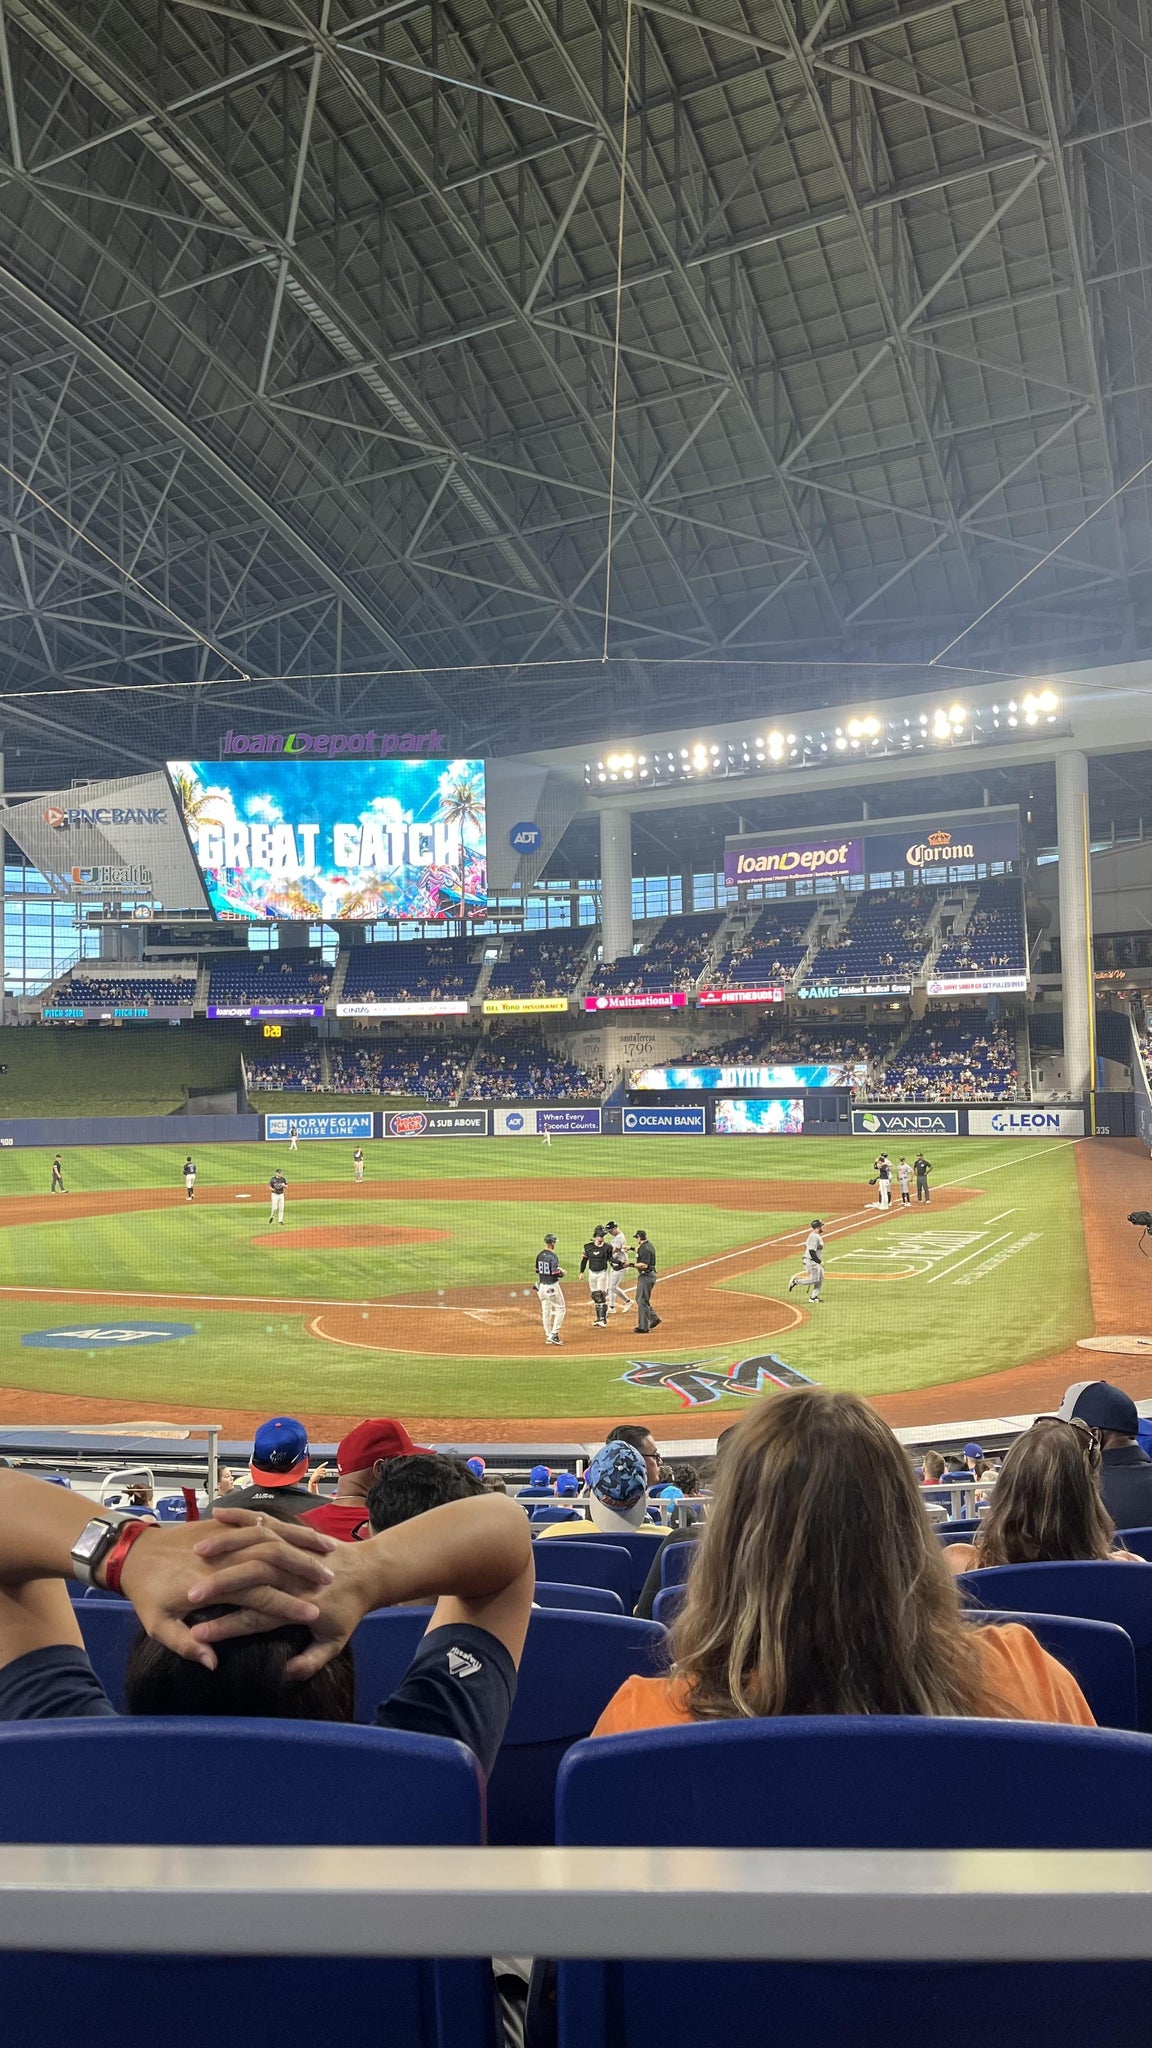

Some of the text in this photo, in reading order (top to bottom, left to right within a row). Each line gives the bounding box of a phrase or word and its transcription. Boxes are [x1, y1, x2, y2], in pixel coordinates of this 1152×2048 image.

[224, 729, 445, 758] loanDepot park
[513, 831, 538, 844] ADT
[199, 823, 460, 868] GREAT CATCH
[737, 844, 849, 874] loanDepot
[906, 843, 975, 867] Corona
[135, 907, 150, 918] 42
[839, 983, 911, 994] Accident Medical Group
[1011, 980, 1024, 988] OVER
[721, 990, 773, 1002] #HITTHEBUDS
[809, 987, 839, 999] AMG
[609, 994, 673, 1008] Multinational
[45, 1009, 84, 1017] PITCH SPEED
[114, 1008, 149, 1017] PITCH TYPE
[215, 1007, 252, 1016] loanDepot
[624, 1041, 653, 1057] 1796
[289, 1117, 369, 1128] NORWEGIAN
[437, 1119, 453, 1127] SUB
[454, 1118, 481, 1127] ABOVE
[508, 1118, 522, 1126] ADT
[543, 1113, 585, 1121] When Every
[639, 1116, 702, 1126] OCEAN BANK
[881, 1116, 946, 1128] VANDA
[1010, 1113, 1060, 1127] LEON
[330, 1127, 353, 1135] LINE
[573, 1122, 599, 1130] Counts.
[1095, 1126, 1110, 1135] 335
[538, 1261, 550, 1275] 88
[46, 1328, 172, 1341] ADT
